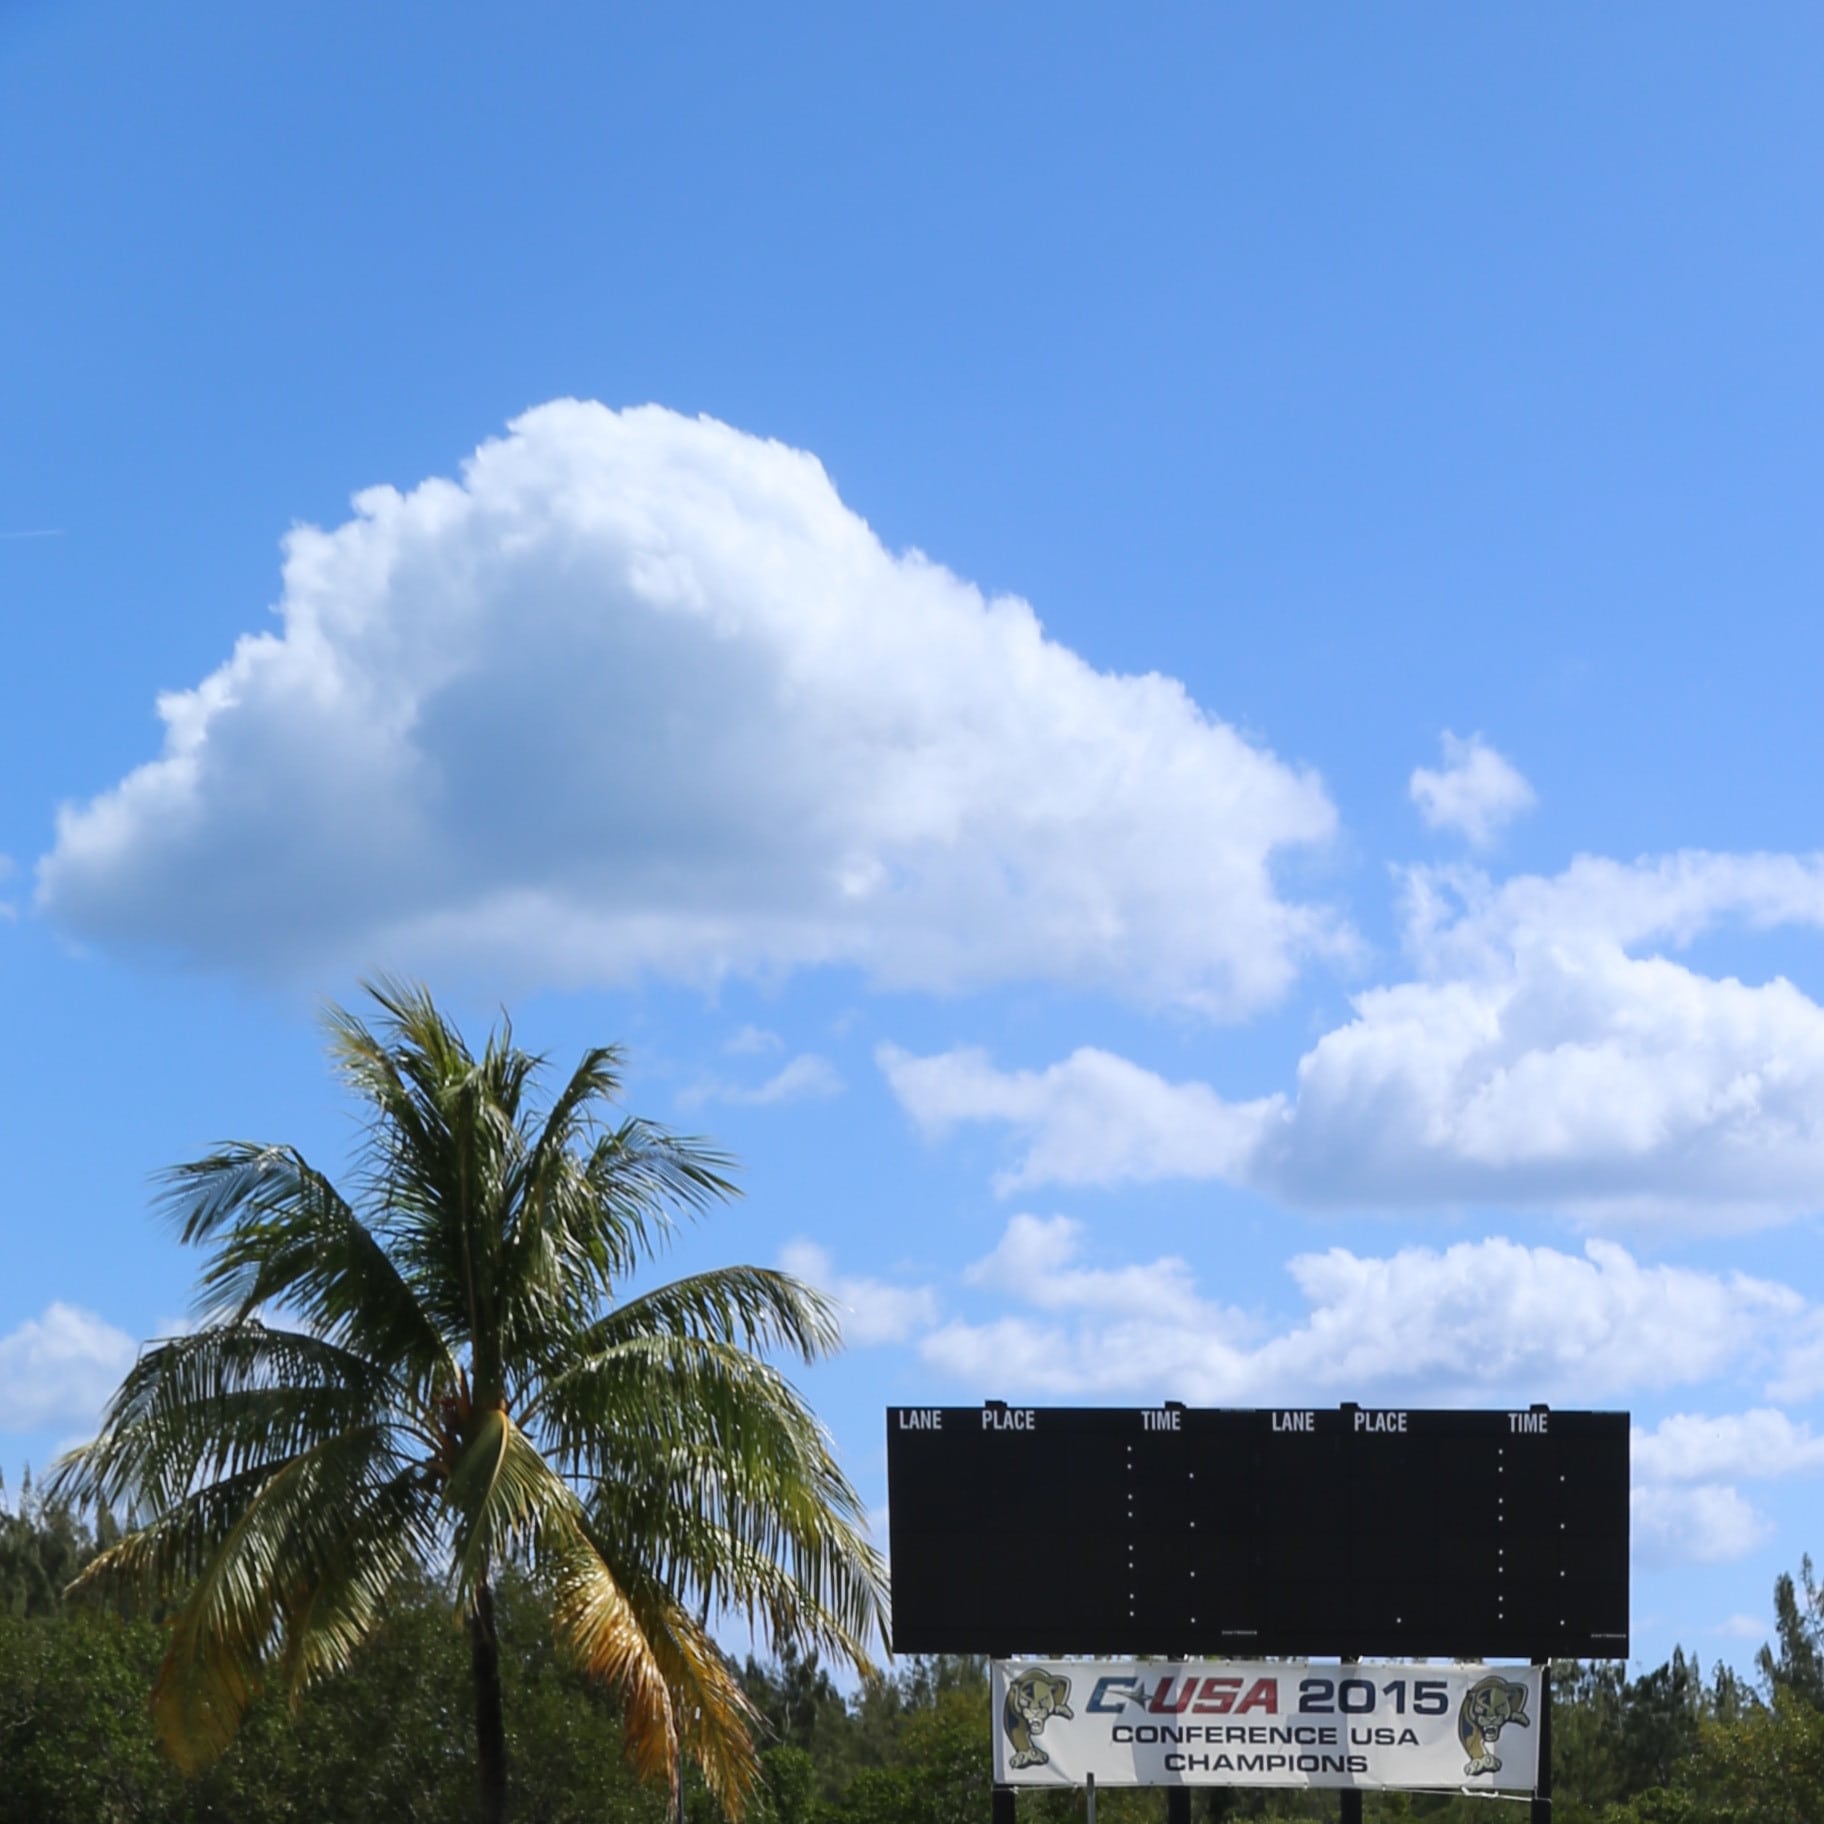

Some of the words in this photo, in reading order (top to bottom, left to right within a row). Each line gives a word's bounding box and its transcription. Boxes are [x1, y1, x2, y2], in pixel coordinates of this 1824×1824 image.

[899, 1410, 942, 1430] LANE
[982, 1410, 1035, 1431] PLACE
[1141, 1410, 1182, 1431] TIME
[1272, 1411, 1315, 1432] LANE
[1354, 1411, 1407, 1432] PLACE
[1508, 1412, 1548, 1433] TIME
[1299, 1678, 1449, 1716] 2015
[1112, 1726, 1337, 1745] CONFERENCE
[1351, 1727, 1420, 1747] USA
[1164, 1753, 1368, 1773] CHAMPIONS
